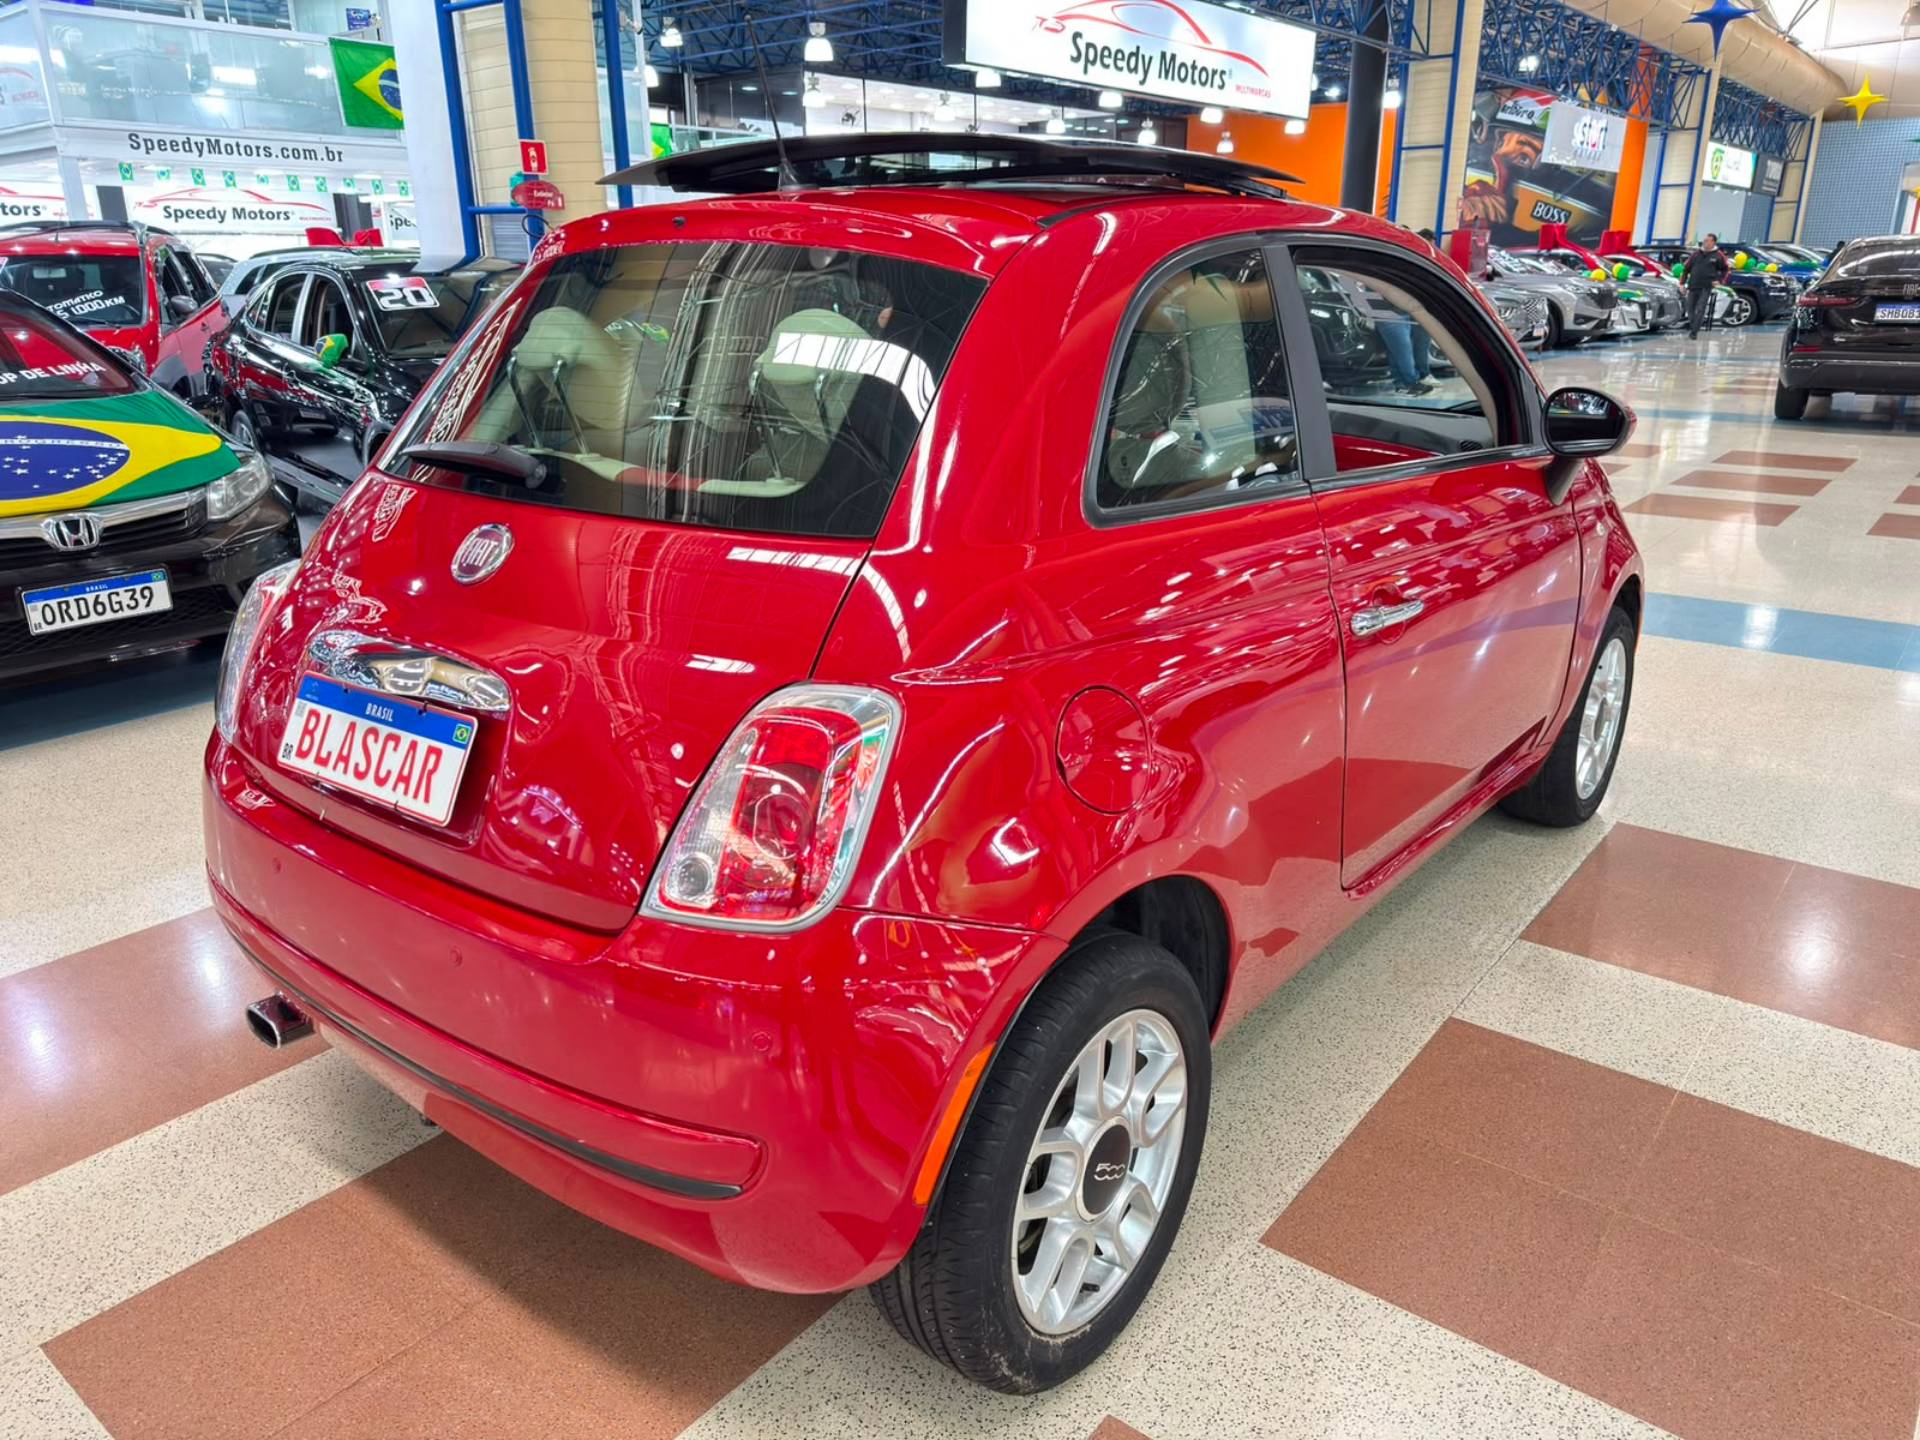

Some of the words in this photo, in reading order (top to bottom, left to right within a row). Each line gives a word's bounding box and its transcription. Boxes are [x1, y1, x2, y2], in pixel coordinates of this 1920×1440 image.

[1070, 31, 1153, 86] Speedy
[1157, 50, 1227, 90] Motors
[127, 132, 344, 163] SpeedyMotors.com.br
[0, 202, 42, 217] tors
[163, 205, 227, 223] Speedy
[232, 207, 291, 221] Motors
[1532, 201, 1570, 224] BOSS
[379, 286, 434, 308] 20
[0, 372, 18, 385] OP
[19, 368, 50, 379] DE
[47, 361, 107, 376] LINHA
[460, 537, 499, 567] FIAT
[365, 702, 394, 722] BRASIL
[294, 708, 444, 804] BLASCAR
[1093, 1163, 1126, 1181] 500
